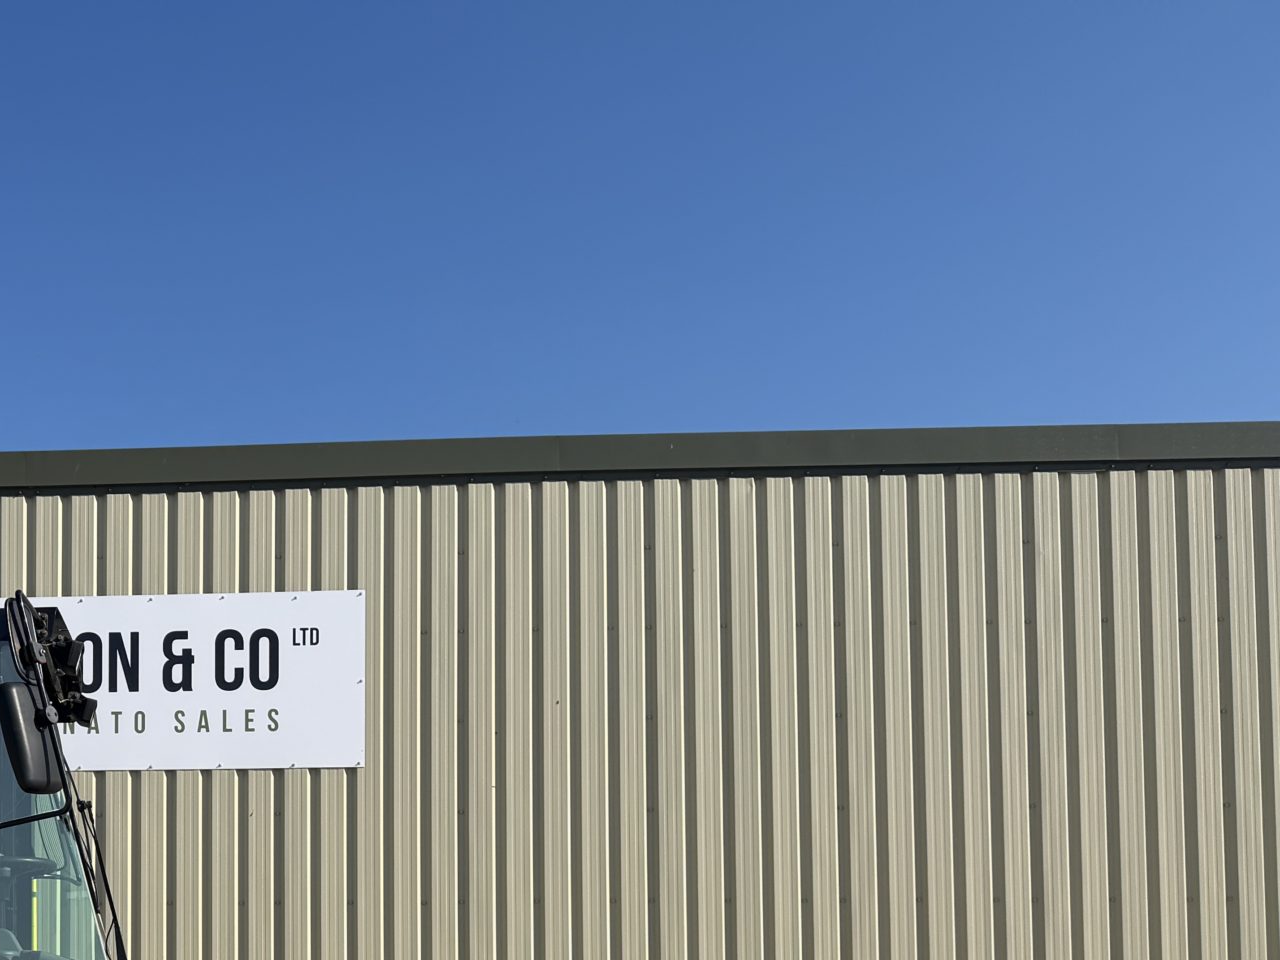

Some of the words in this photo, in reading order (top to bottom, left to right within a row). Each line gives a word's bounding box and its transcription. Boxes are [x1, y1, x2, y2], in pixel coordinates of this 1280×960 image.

[162, 630, 195, 693] &
[214, 628, 280, 692] CO
[292, 627, 320, 647] LTD
[173, 708, 280, 733] SALES
